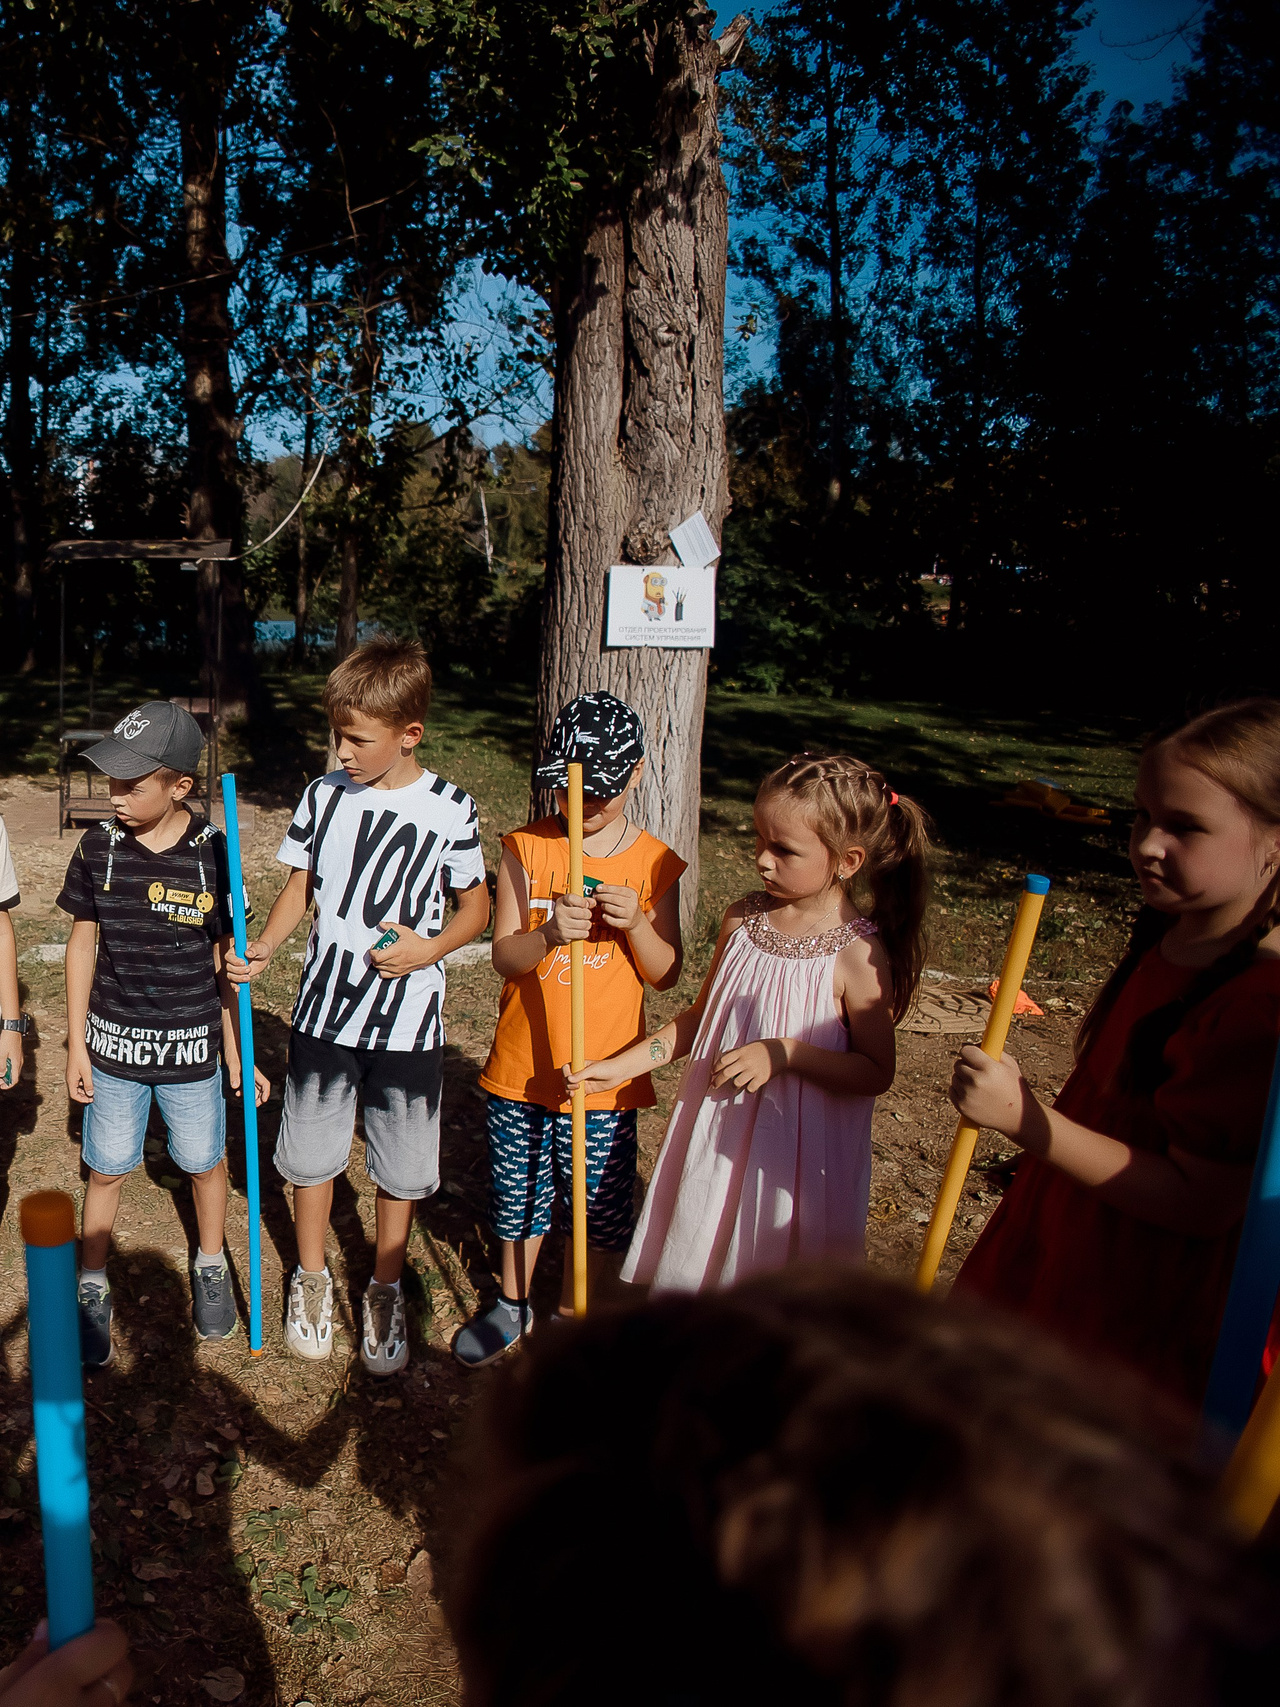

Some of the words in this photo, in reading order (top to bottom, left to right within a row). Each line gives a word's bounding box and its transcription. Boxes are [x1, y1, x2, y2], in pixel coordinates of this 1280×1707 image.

[336, 809, 450, 931] YOU
[151, 902, 176, 913] LIKE
[90, 1012, 120, 1036] BRAND
[131, 1027, 164, 1041] CITY
[167, 1025, 209, 1041] BRAND
[91, 1026, 172, 1066] MERCY
[174, 1038, 208, 1066] NO
